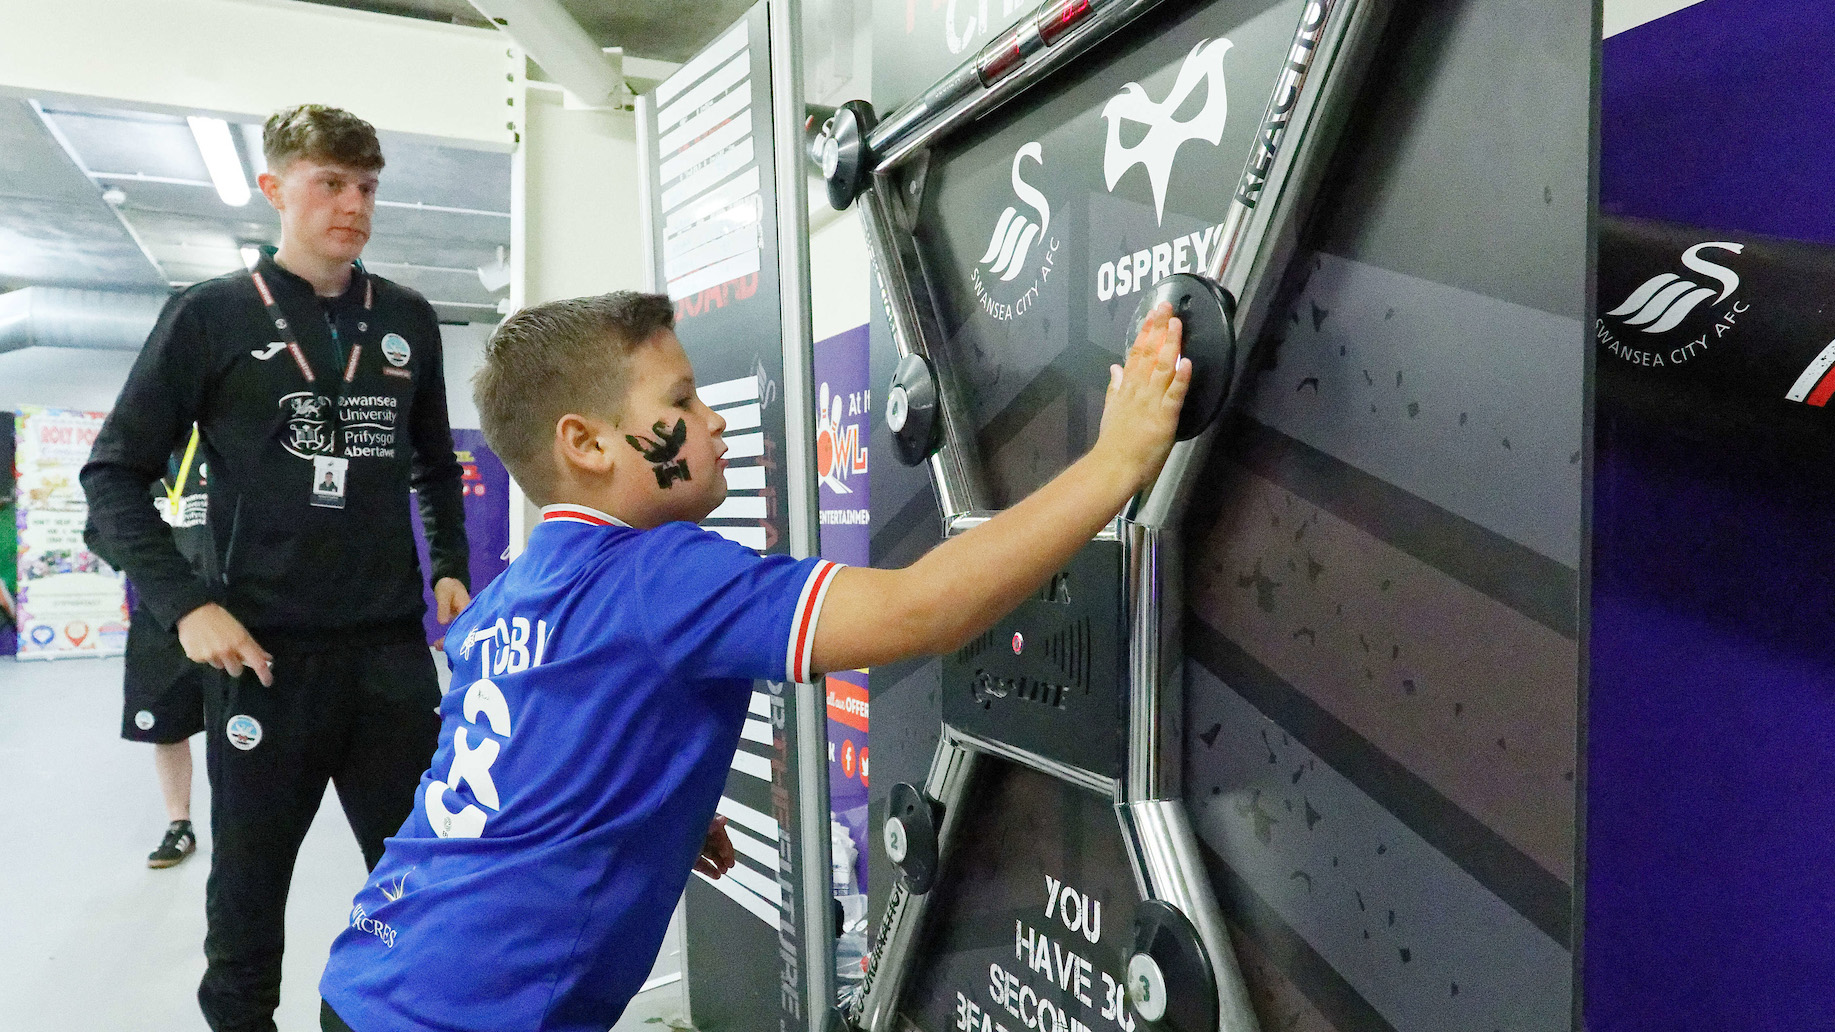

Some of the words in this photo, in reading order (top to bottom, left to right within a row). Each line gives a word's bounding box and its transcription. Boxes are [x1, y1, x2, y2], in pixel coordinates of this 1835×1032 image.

[970, 267, 1013, 321] SWANSEA
[1016, 280, 1039, 316] CITY
[1041, 236, 1060, 283] AFC
[1595, 318, 1665, 367] SWANSEA
[1670, 334, 1708, 364] CITY
[1714, 300, 1750, 338] AFC
[339, 408, 397, 424] University
[344, 430, 395, 447] Prifysgol
[344, 445, 395, 459] Abertawe
[890, 831, 899, 852] 2
[1044, 874, 1101, 944] YOU
[1014, 918, 1093, 1008] HAVE
[1138, 974, 1151, 1002] 3
